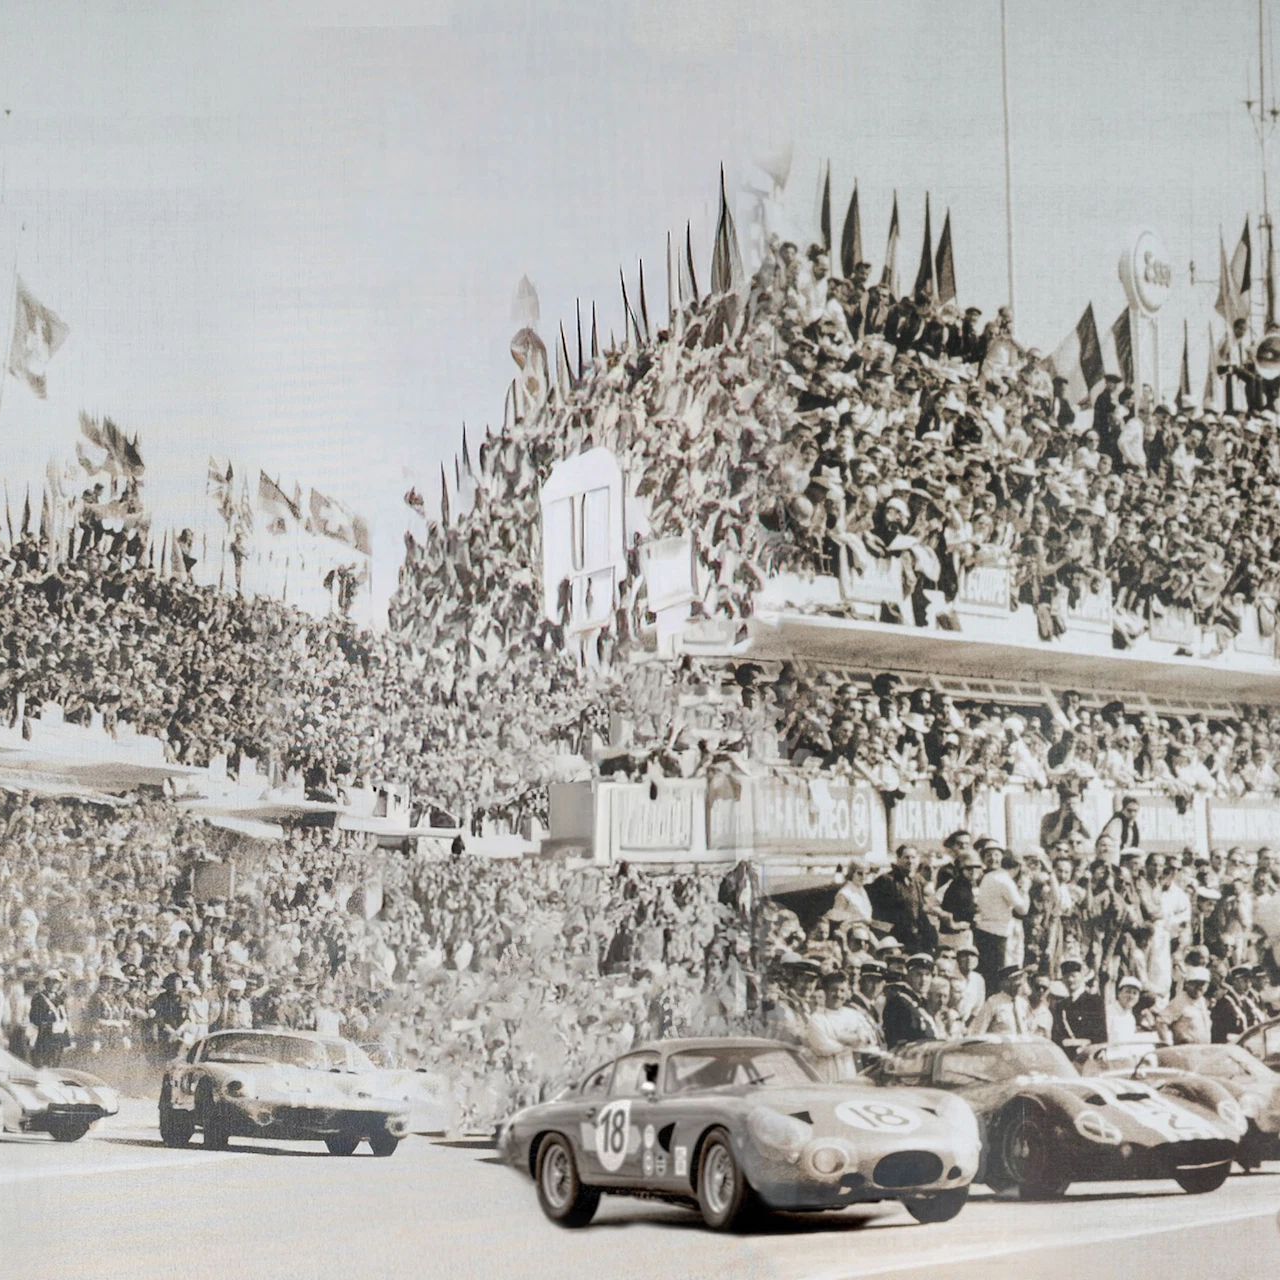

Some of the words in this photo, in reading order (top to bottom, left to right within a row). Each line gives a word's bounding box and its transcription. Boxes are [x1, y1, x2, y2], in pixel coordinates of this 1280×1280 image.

[925, 800, 967, 840] ROME
[600, 1109, 626, 1154] 18
[848, 1105, 910, 1128] 18
